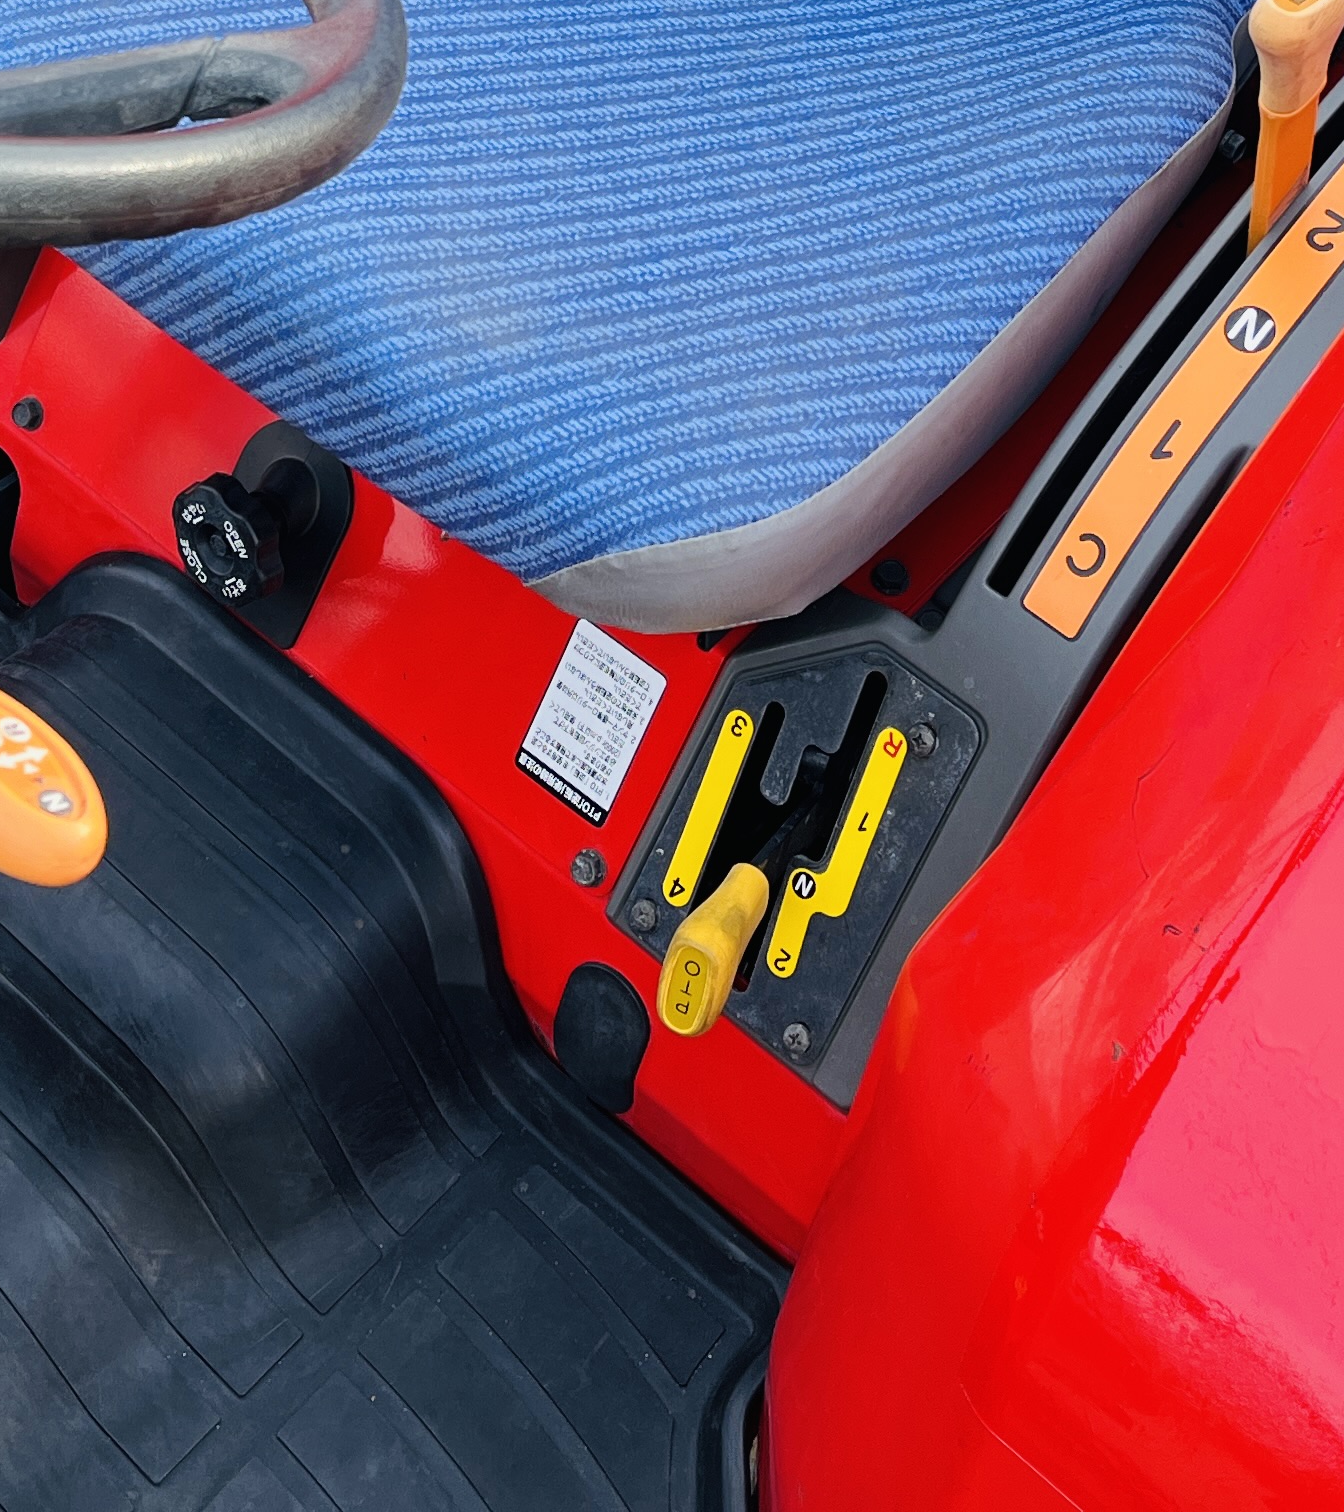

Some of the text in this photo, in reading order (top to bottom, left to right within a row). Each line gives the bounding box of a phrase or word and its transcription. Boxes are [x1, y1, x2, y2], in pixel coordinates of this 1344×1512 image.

[1229, 309, 1272, 352] N
[1149, 418, 1183, 461] 1
[181, 502, 206, 524] はやい
[223, 520, 249, 559] OPEN
[179, 537, 208, 584] CLOSE
[1064, 532, 1108, 578] C
[221, 578, 248, 599] おそい
[730, 715, 749, 737] 3
[882, 732, 905, 759] R
[856, 813, 871, 833] 1
[667, 877, 687, 898] 4
[795, 874, 814, 895] N
[772, 947, 792, 972] 2
[675, 959, 701, 1015] PTO
